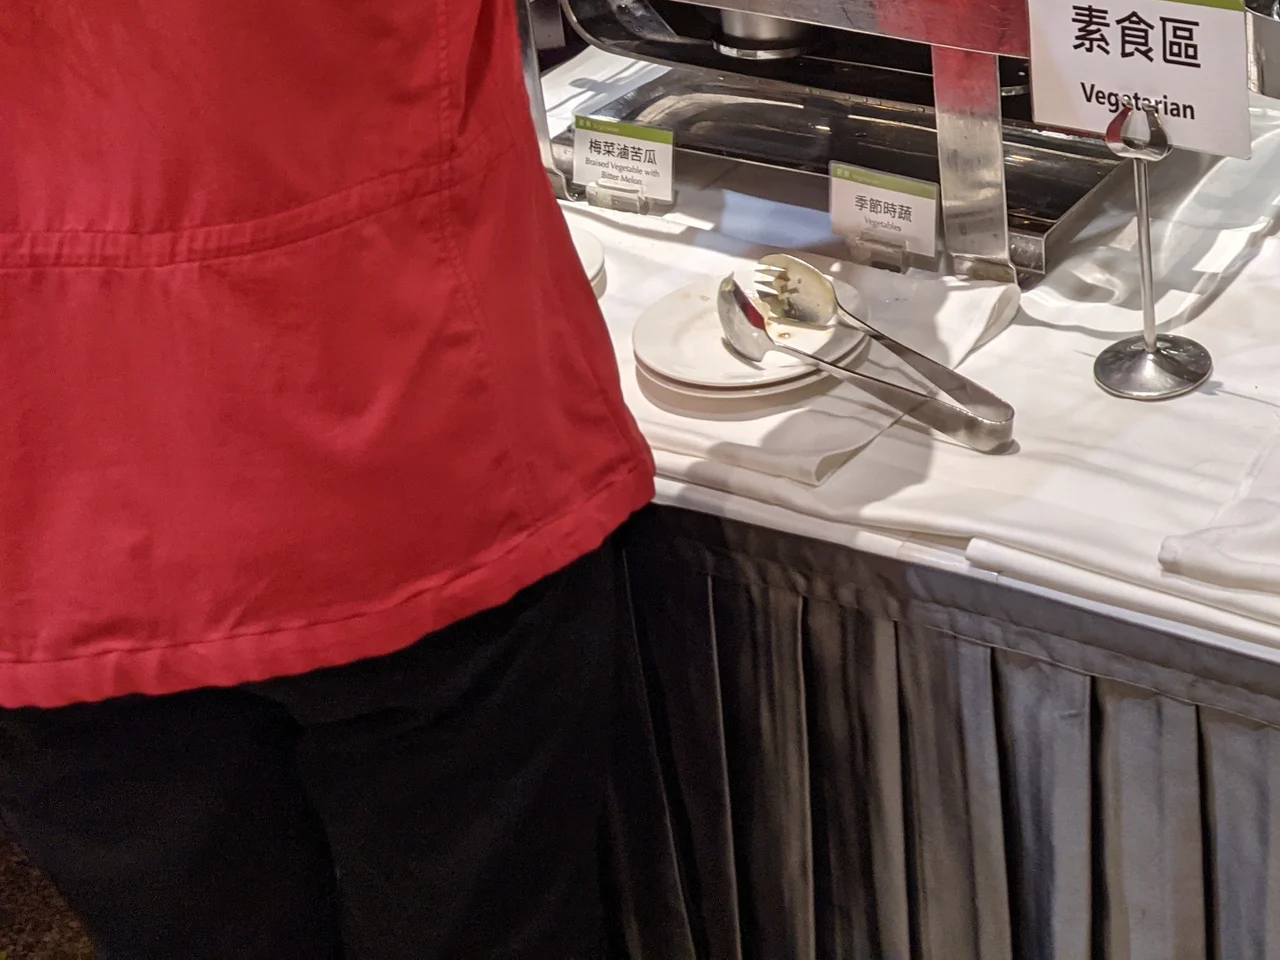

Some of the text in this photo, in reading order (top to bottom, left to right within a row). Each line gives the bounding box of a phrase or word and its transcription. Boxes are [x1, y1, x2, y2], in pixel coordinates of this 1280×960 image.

[1071, 4, 1201, 68] 素食區
[589, 138, 657, 165] 梅菜滷苦瓜
[585, 157, 660, 178] Braised Vegetable with
[855, 194, 912, 222] 季節時蔬
[864, 216, 902, 232] Vegetables
